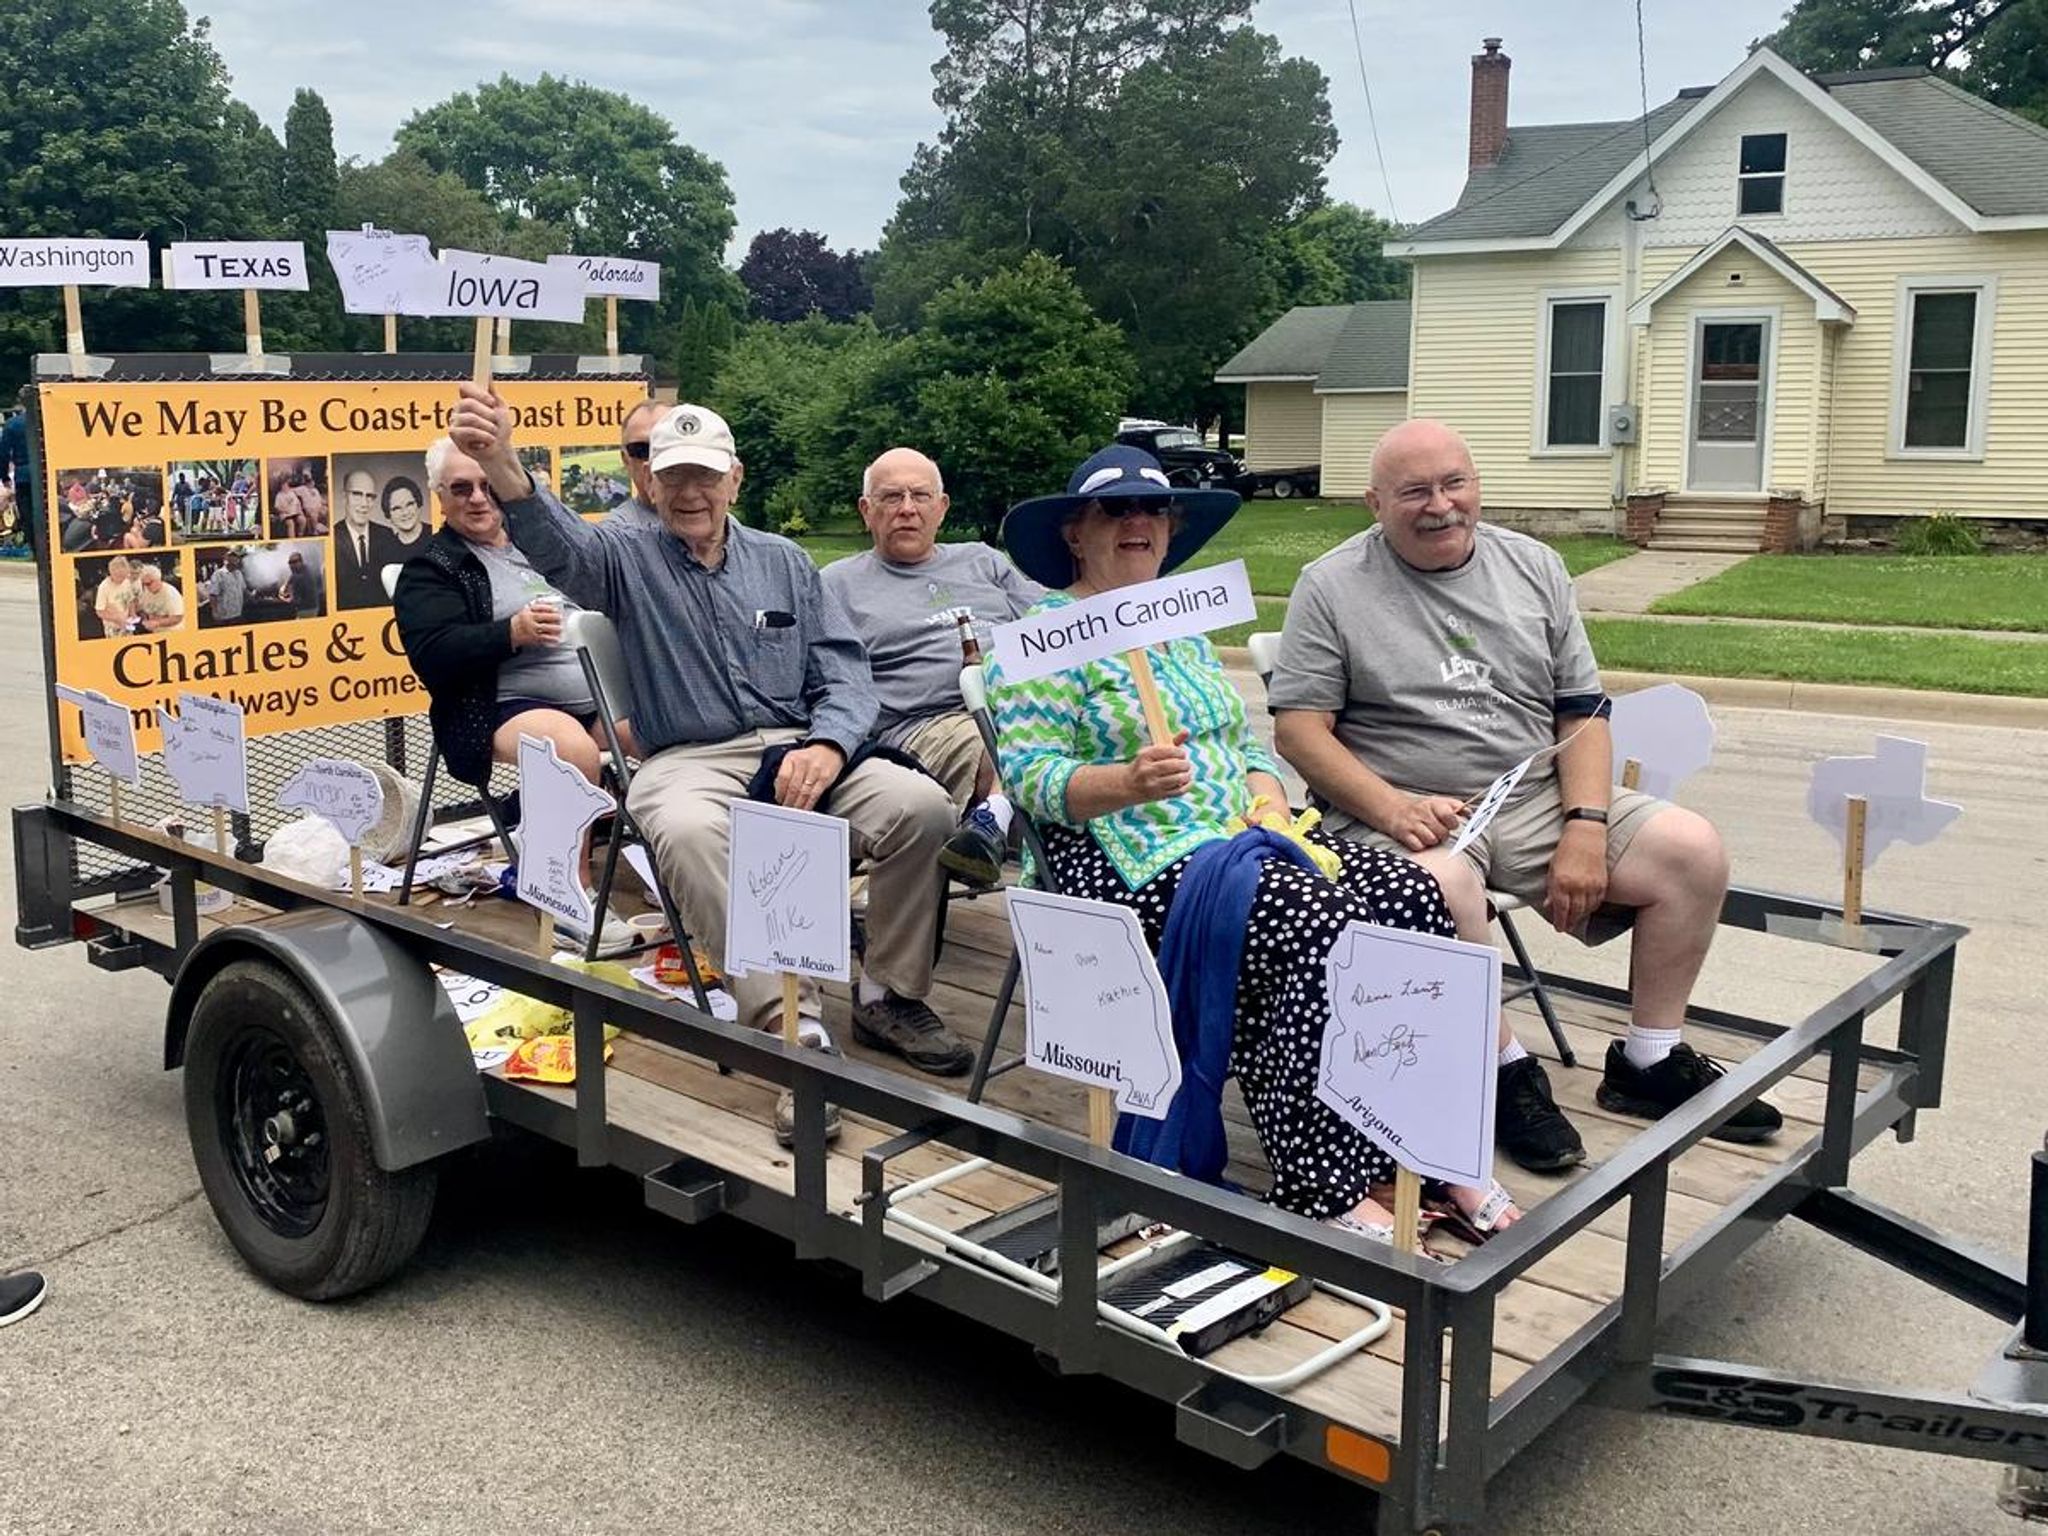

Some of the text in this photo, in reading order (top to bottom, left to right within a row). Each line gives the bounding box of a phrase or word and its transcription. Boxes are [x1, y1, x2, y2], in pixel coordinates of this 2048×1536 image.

[194, 254, 292, 278] TEXAS
[577, 258, 645, 284] Colorado
[447, 270, 540, 309] Iowa
[75, 400, 143, 438] We
[156, 399, 248, 447] May
[259, 399, 308, 434] Be
[574, 396, 624, 428] But
[1019, 584, 1229, 658] North Carolina
[112, 630, 309, 690] Charles
[325, 621, 367, 664] &
[527, 883, 579, 919] Minnesota
[773, 950, 835, 973] New Mexico
[1041, 1041, 1123, 1083] Missouri
[1347, 1095, 1403, 1148] Arizona
